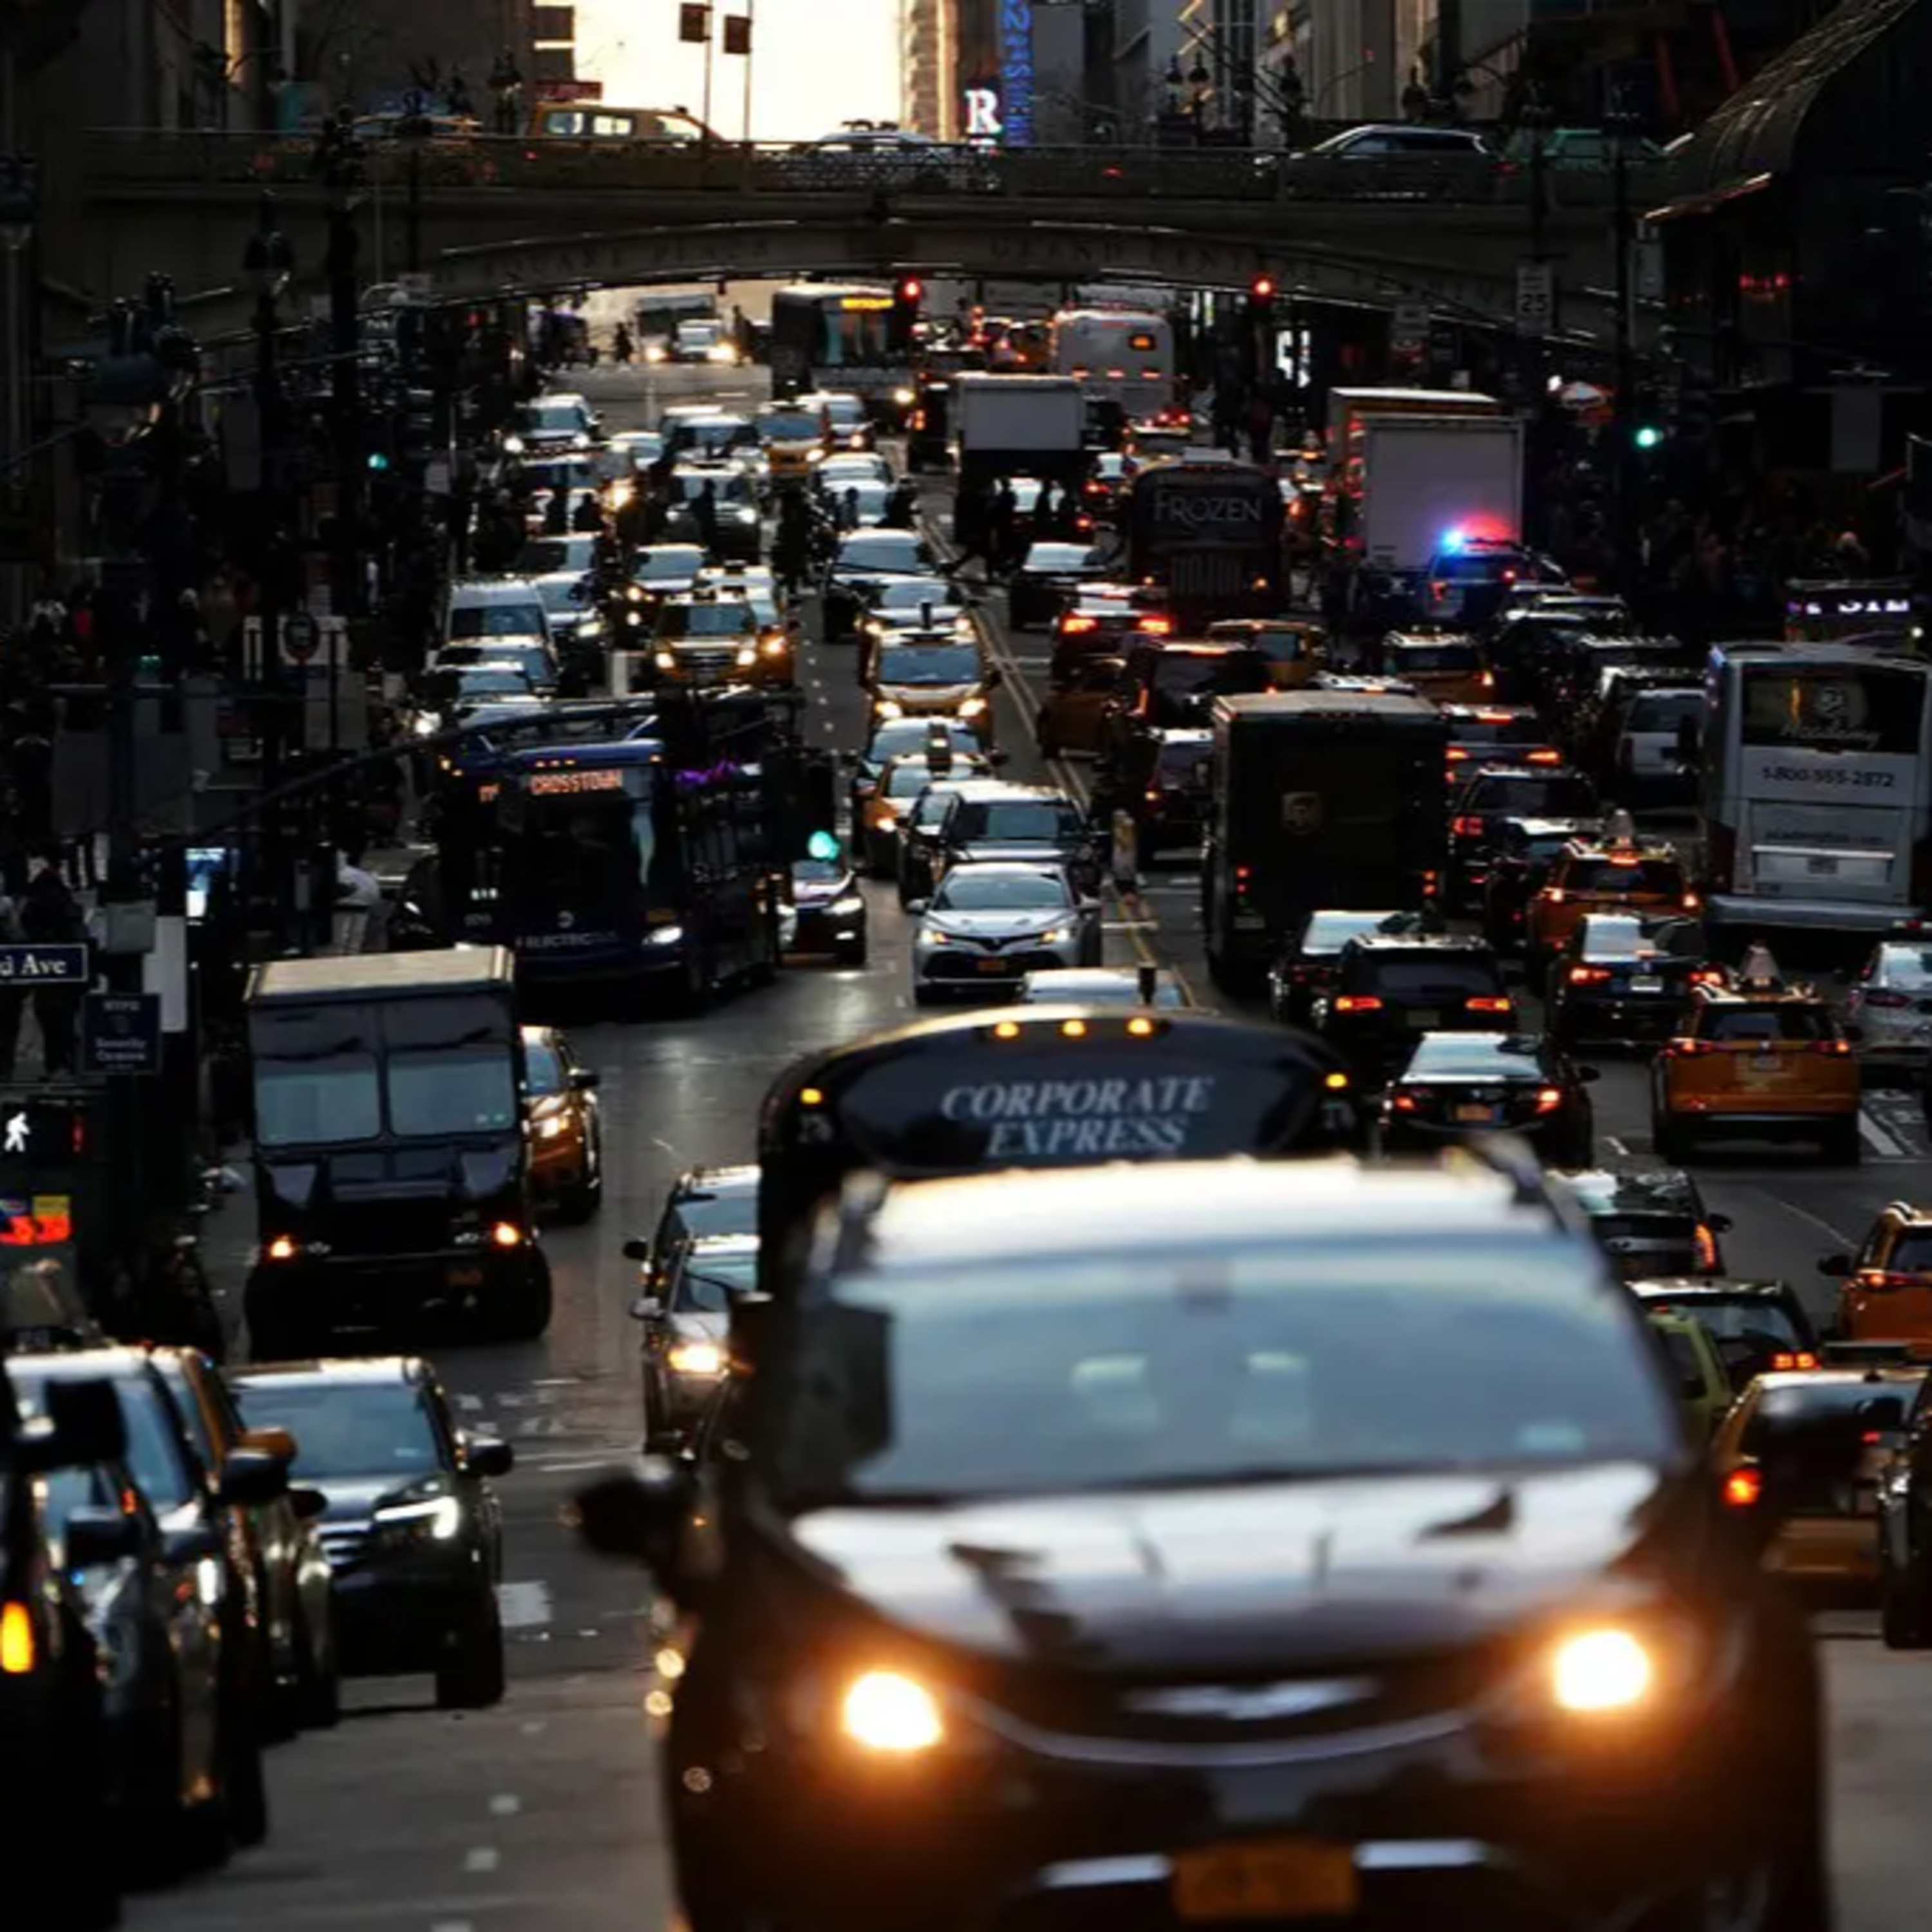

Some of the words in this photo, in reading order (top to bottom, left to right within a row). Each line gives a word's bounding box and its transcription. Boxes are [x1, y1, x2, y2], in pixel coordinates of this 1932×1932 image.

[1522, 294, 1547, 312] 25
[1154, 488, 1262, 529] FROZEN
[21, 952, 67, 975] Ave
[942, 1076, 1215, 1121] CORPORATE
[986, 1114, 1190, 1156] EXPRESS
